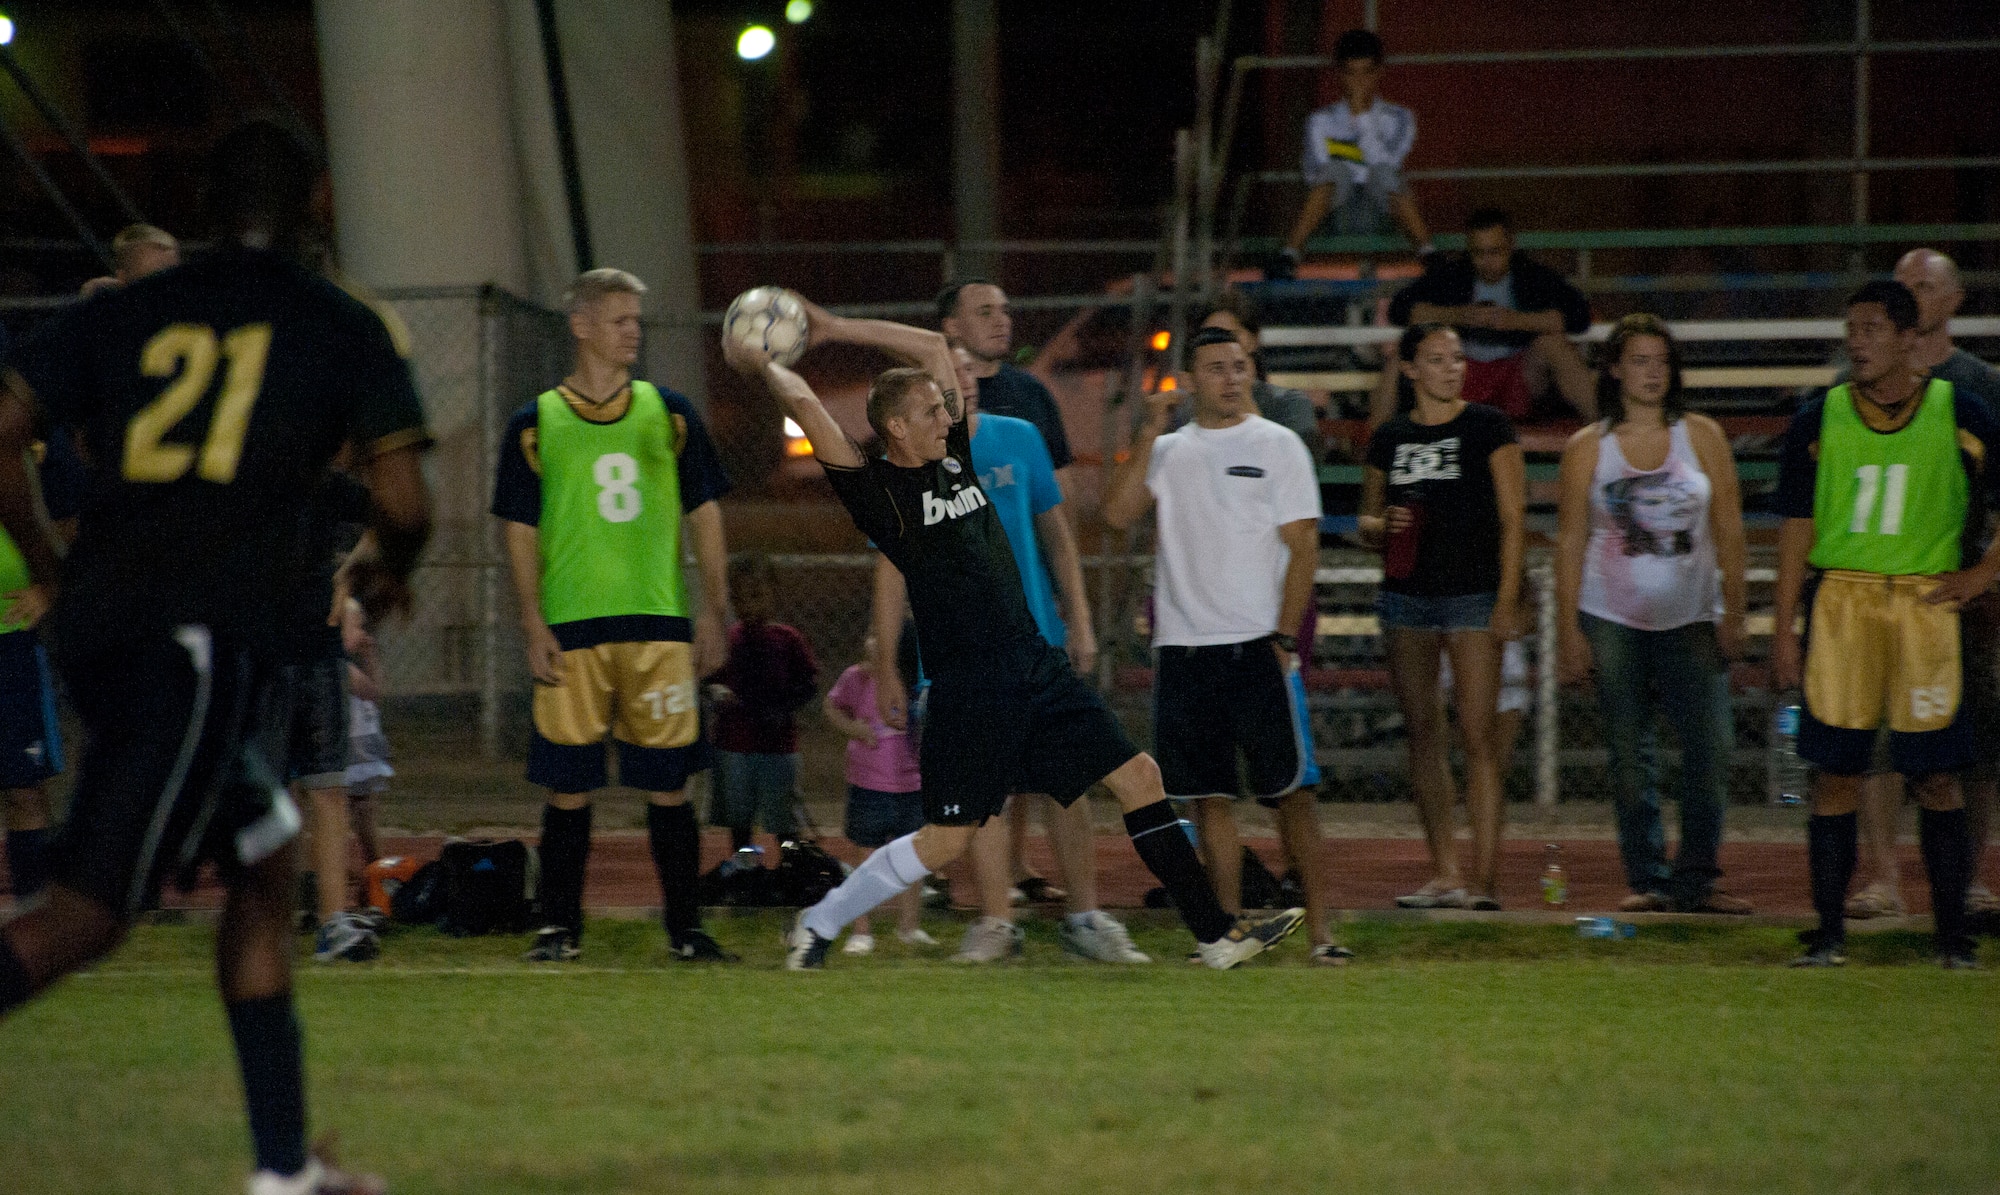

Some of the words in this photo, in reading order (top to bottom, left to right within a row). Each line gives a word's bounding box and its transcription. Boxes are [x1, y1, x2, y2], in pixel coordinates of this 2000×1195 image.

[123, 321, 272, 484] 21
[594, 453, 641, 522] 8
[922, 483, 987, 525] bwin
[1850, 464, 1908, 534] 11
